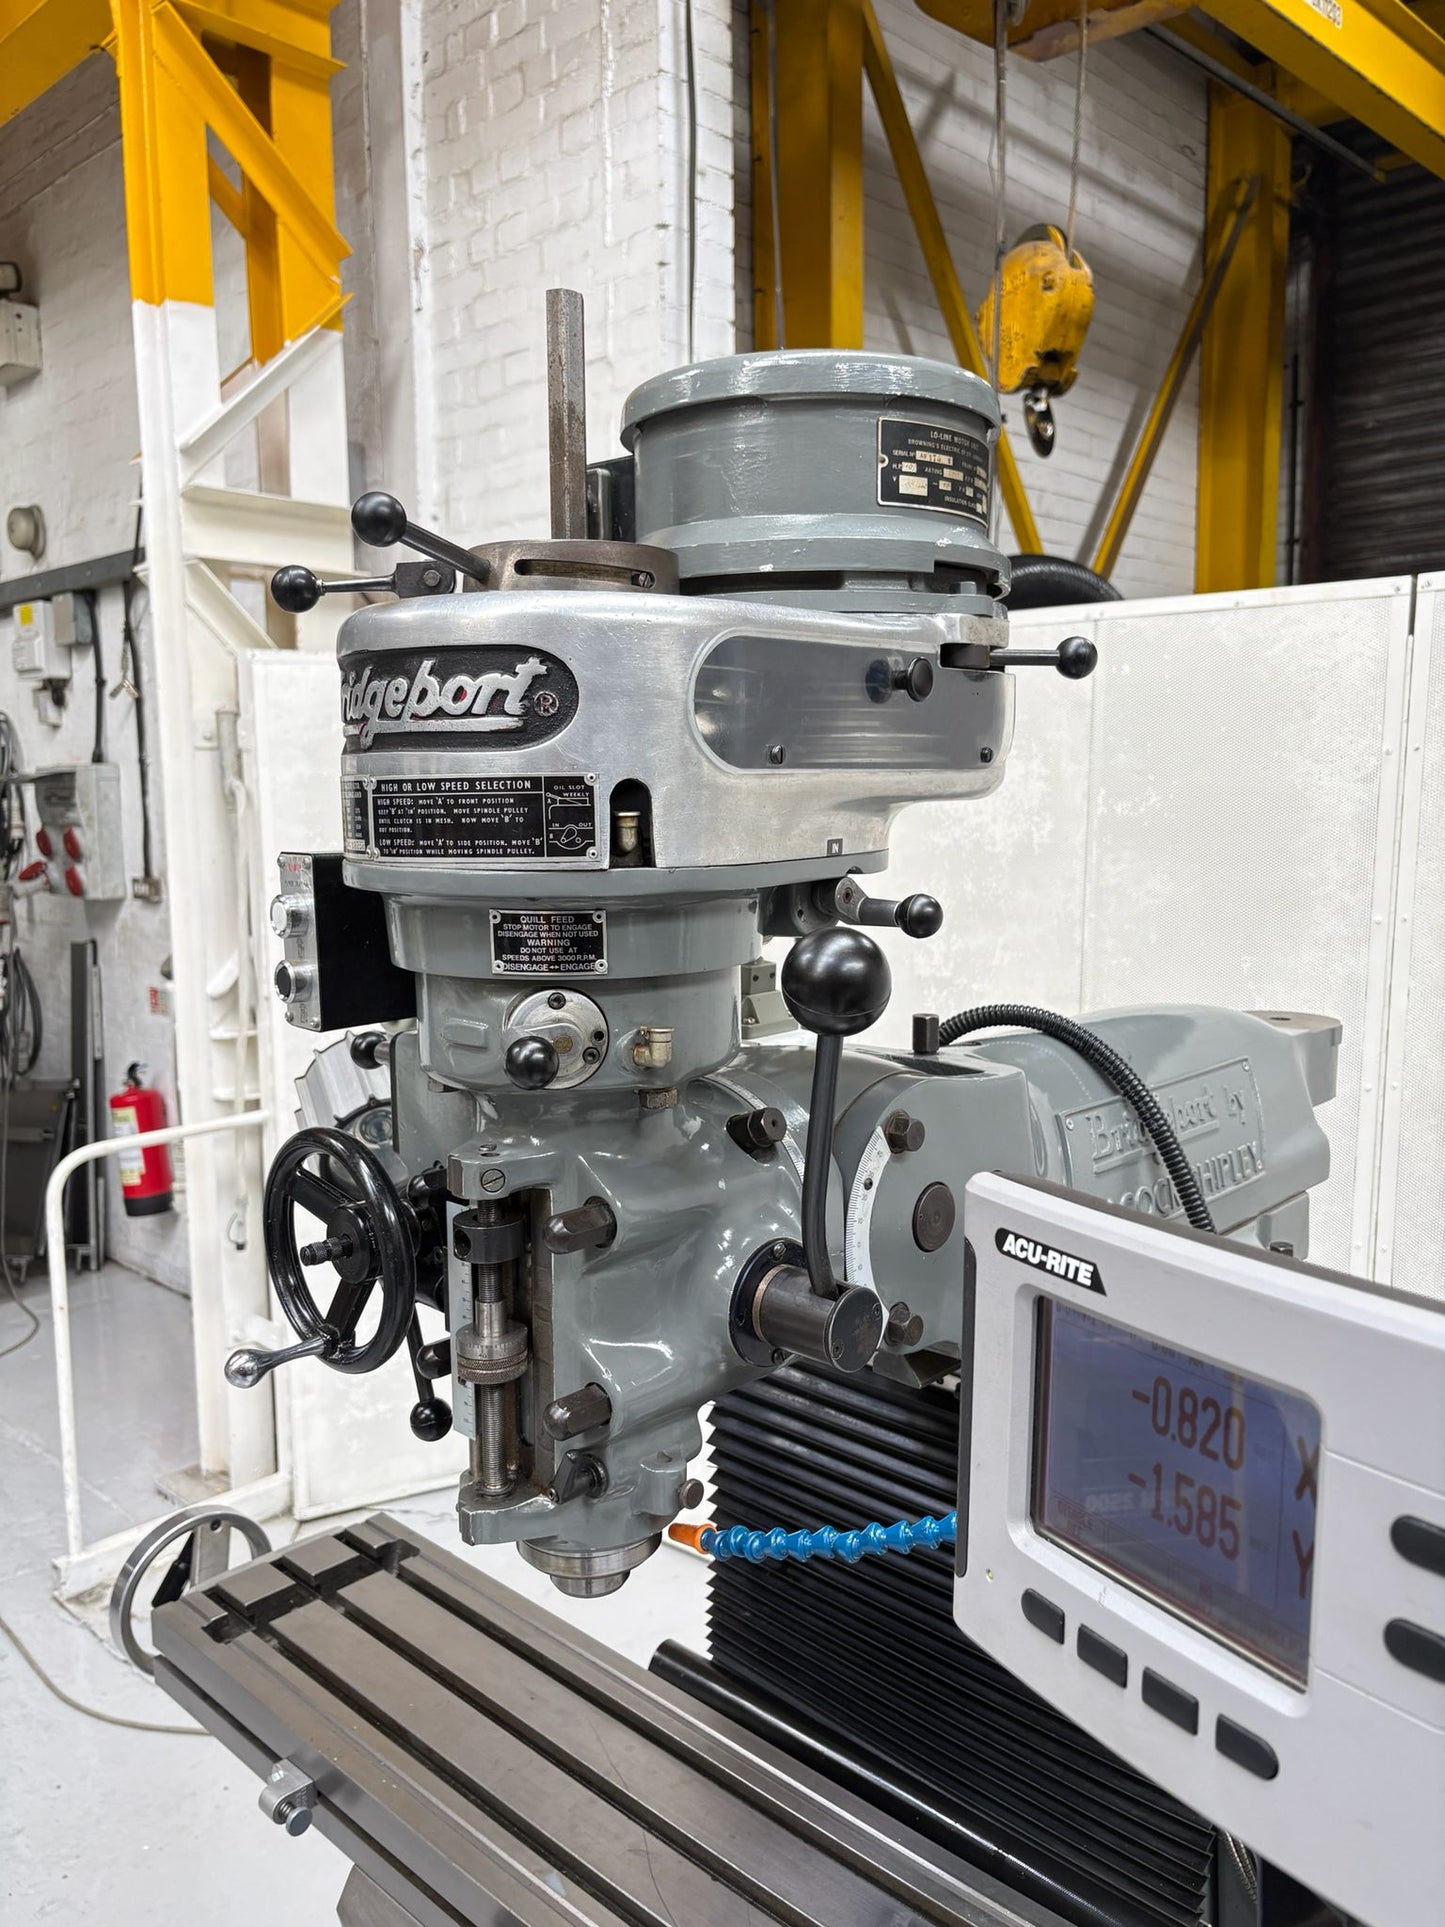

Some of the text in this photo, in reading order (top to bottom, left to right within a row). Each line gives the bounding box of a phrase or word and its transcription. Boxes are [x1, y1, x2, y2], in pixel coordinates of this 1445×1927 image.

[930, 431, 952, 442] LO-LINE
[381, 780, 531, 792] HIGH OR LOW SPEED SELECTION
[520, 916, 546, 924] QUILL
[498, 930, 538, 938] DISENGAGE
[1002, 1233, 1094, 1287] ACU-RITE
[1132, 1376, 1320, 1512] -0.820 X
[1128, 1462, 1316, 1599] -1.585 Y
